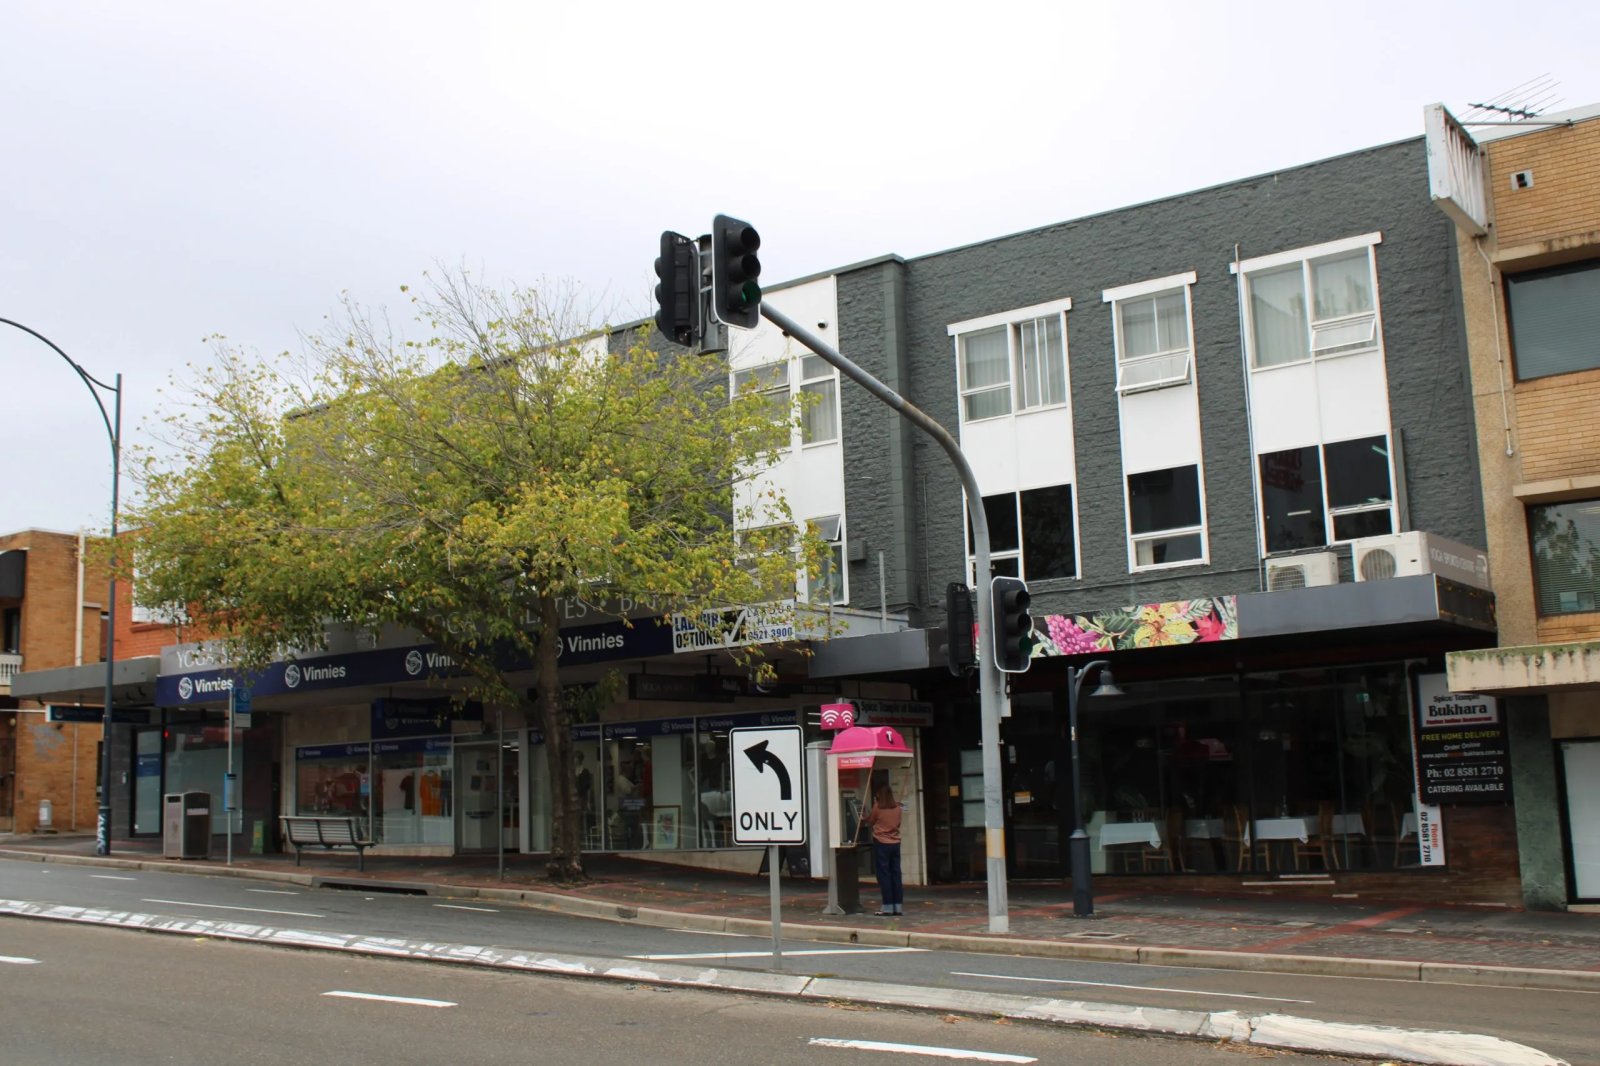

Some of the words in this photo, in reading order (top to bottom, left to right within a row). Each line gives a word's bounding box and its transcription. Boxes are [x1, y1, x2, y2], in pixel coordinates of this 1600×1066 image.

[567, 632, 625, 653] Vinnies
[302, 664, 346, 681] Vinnies
[195, 677, 233, 693] Vinnies
[1428, 704, 1487, 717] Bukhara
[1426, 769, 1443, 778] Ph:
[1444, 768, 1456, 777] 02
[1457, 767, 1478, 776] 8581
[1480, 766, 1504, 775] 2710
[1427, 785, 1464, 794] CATERING
[1464, 782, 1504, 792] AVAILABLE
[740, 811, 798, 831] ONLY
